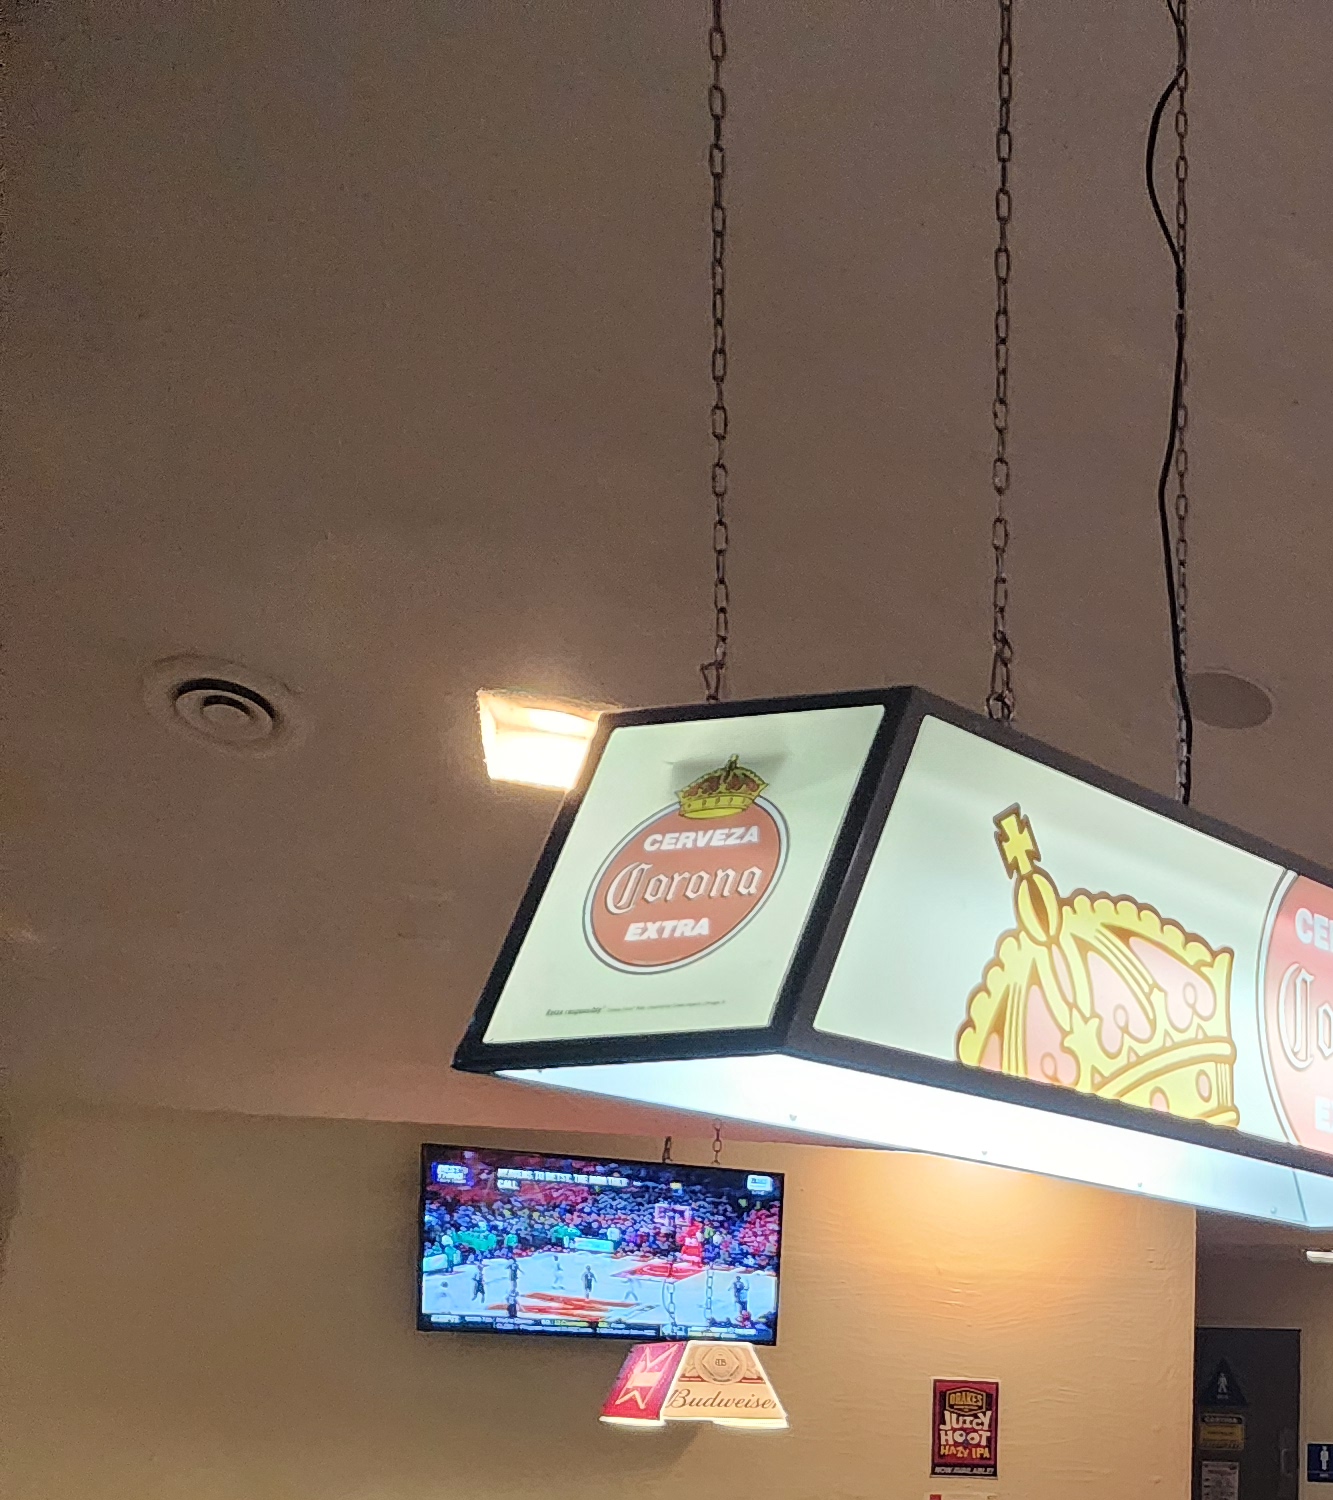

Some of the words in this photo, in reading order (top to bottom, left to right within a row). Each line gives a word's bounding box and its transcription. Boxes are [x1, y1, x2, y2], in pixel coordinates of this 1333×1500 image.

[644, 826, 759, 853] CERVEZA
[605, 862, 764, 915] Corona
[625, 917, 710, 942] EXTRA
[664, 1388, 777, 1409] Budweiser
[939, 1410, 992, 1430] JUICY
[939, 1430, 991, 1446] HOOT
[940, 1445, 969, 1458] HAZY
[971, 1447, 991, 1459] IPA
[934, 1466, 954, 1474] NOW
